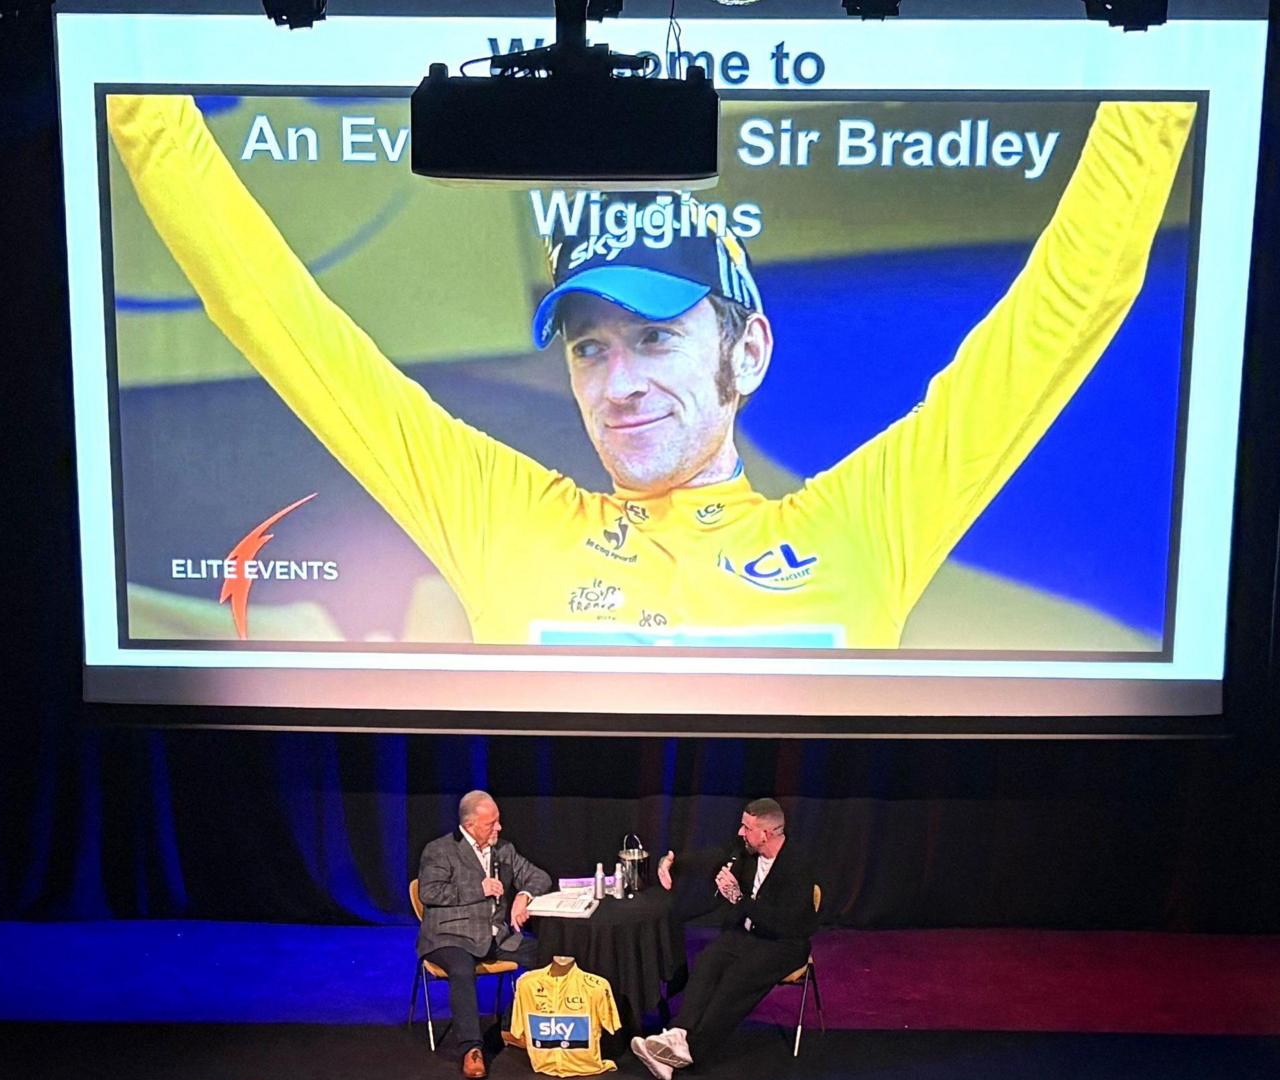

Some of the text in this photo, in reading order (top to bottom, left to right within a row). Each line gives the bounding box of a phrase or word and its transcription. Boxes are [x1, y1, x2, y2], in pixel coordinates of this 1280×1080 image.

[771, 40, 826, 85] to
[240, 114, 318, 162] An
[736, 117, 821, 167] Sir
[837, 118, 1061, 180] Bradley
[528, 189, 763, 250] Wiggins
[171, 559, 340, 580] ELITE EVENTS
[538, 1017, 576, 1042] sky
